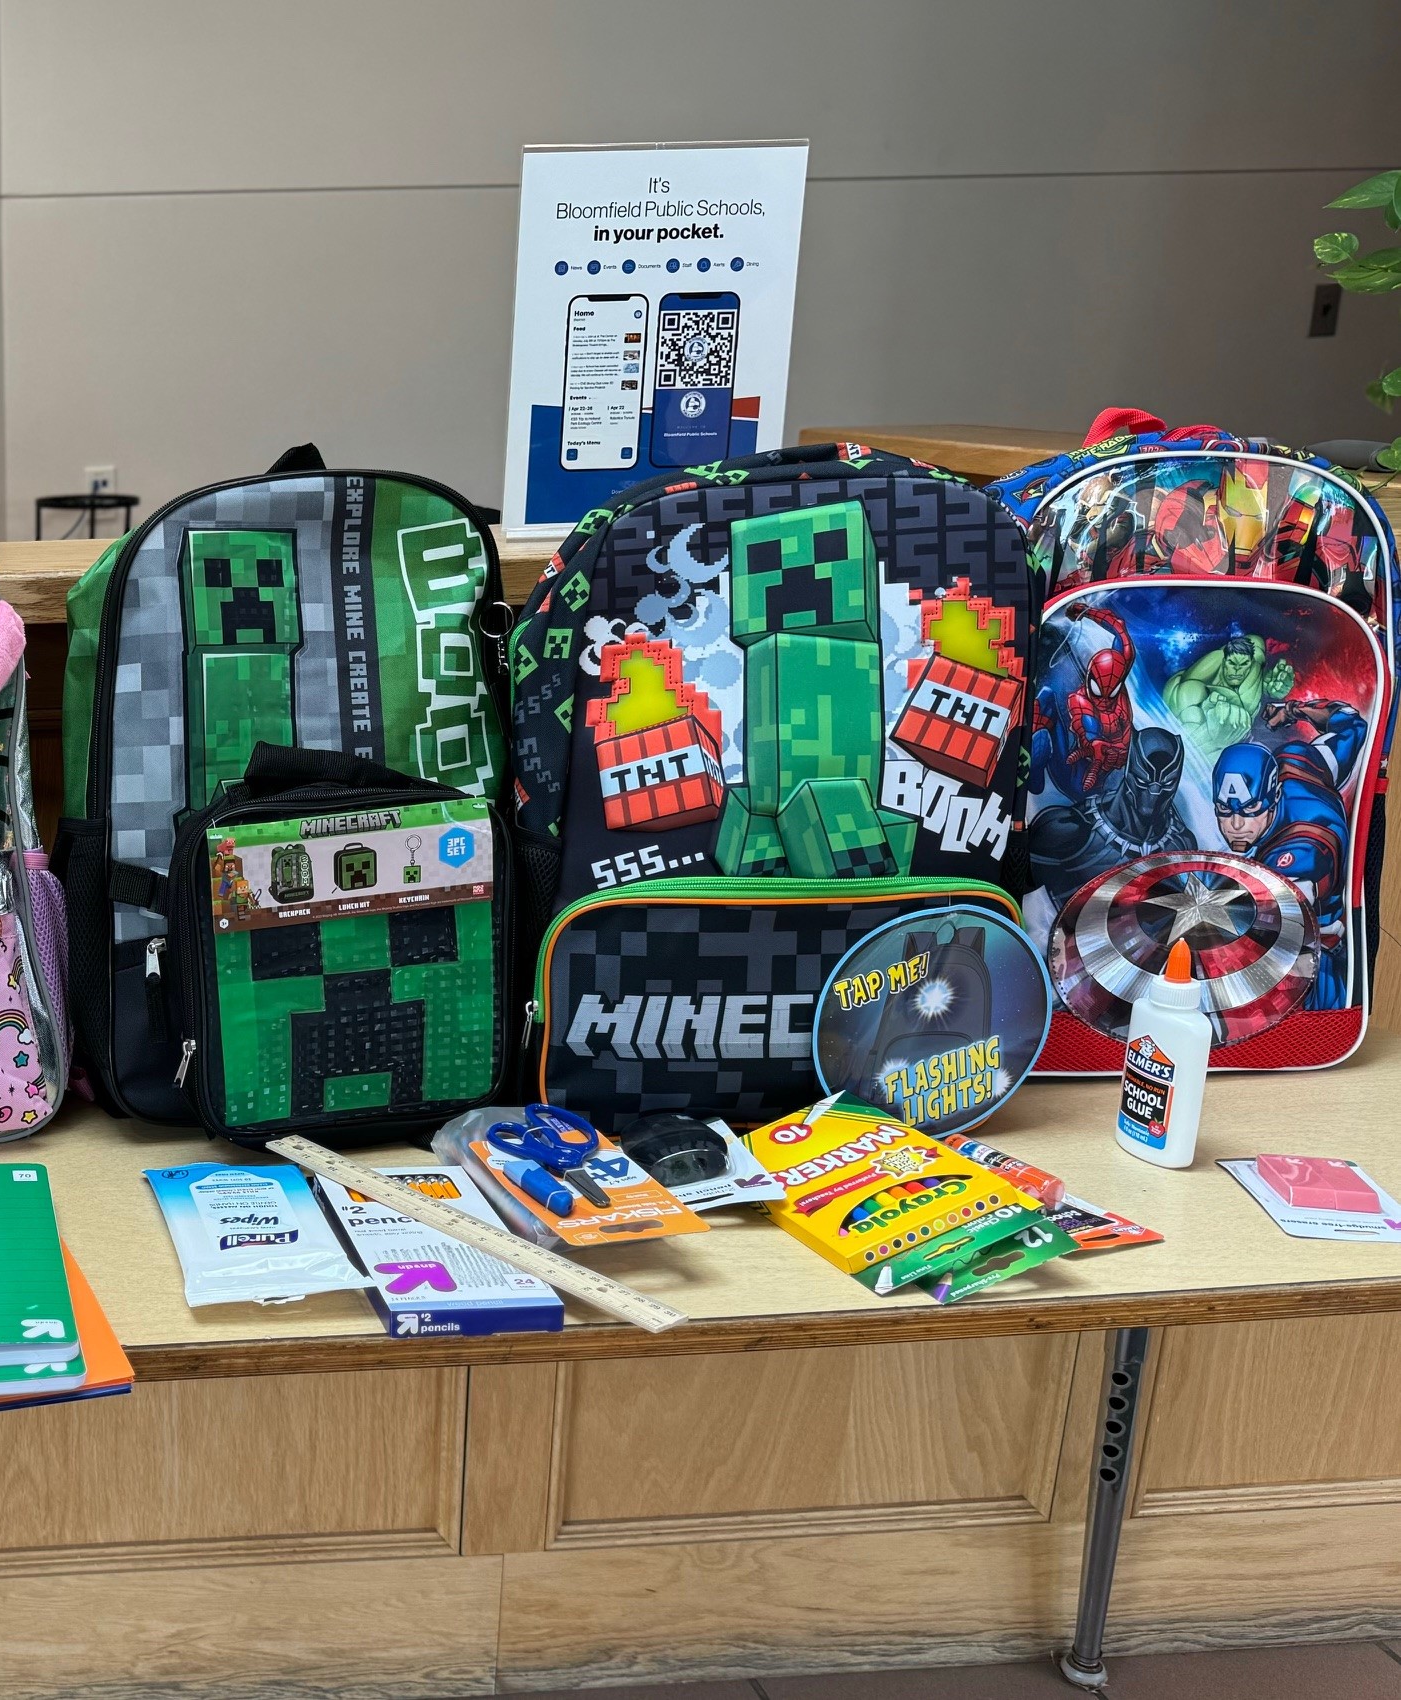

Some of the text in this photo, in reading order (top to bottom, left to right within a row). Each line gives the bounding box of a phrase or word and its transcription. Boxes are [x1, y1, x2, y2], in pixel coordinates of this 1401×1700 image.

[648, 177, 670, 193] It's
[556, 198, 766, 219] Bloomfield Public Schools,
[594, 223, 725, 244] in your pocket.
[342, 475, 372, 733] EXPLORE MINE CREATE
[928, 687, 1002, 728] TNT
[610, 751, 691, 793] TNT
[880, 757, 1014, 863] BOOM
[299, 809, 403, 840] MINECRAFT
[446, 836, 466, 848] 3PC
[446, 846, 466, 857] SET
[338, 900, 370, 911] LUNCH KIT
[398, 894, 430, 903] KEYCHAIN
[278, 908, 311, 918] BACKPACK
[833, 951, 931, 1013] TAP ME!
[884, 1035, 1002, 1106] FLASHING
[1127, 1049, 1172, 1078] ELMER'S
[900, 1074, 995, 1127] LIGHTS!
[1124, 1079, 1164, 1109] SCHOOL
[1126, 1097, 1154, 1119] GLUE
[774, 1125, 809, 1142] 10
[772, 1125, 907, 1186] MARKER
[16, 1172, 33, 1180] 70
[558, 1205, 683, 1229] FISKARS
[850, 1180, 968, 1234] Crayola
[220, 1213, 279, 1226] Wipes
[1321, 1222, 1387, 1230] smudge-free
[226, 1233, 292, 1246] Purell
[1013, 1226, 1053, 1248] 12
[514, 1277, 536, 1285] 24
[950, 1273, 1001, 1298] Pre-Sharpened
[420, 1323, 461, 1333] pencils
